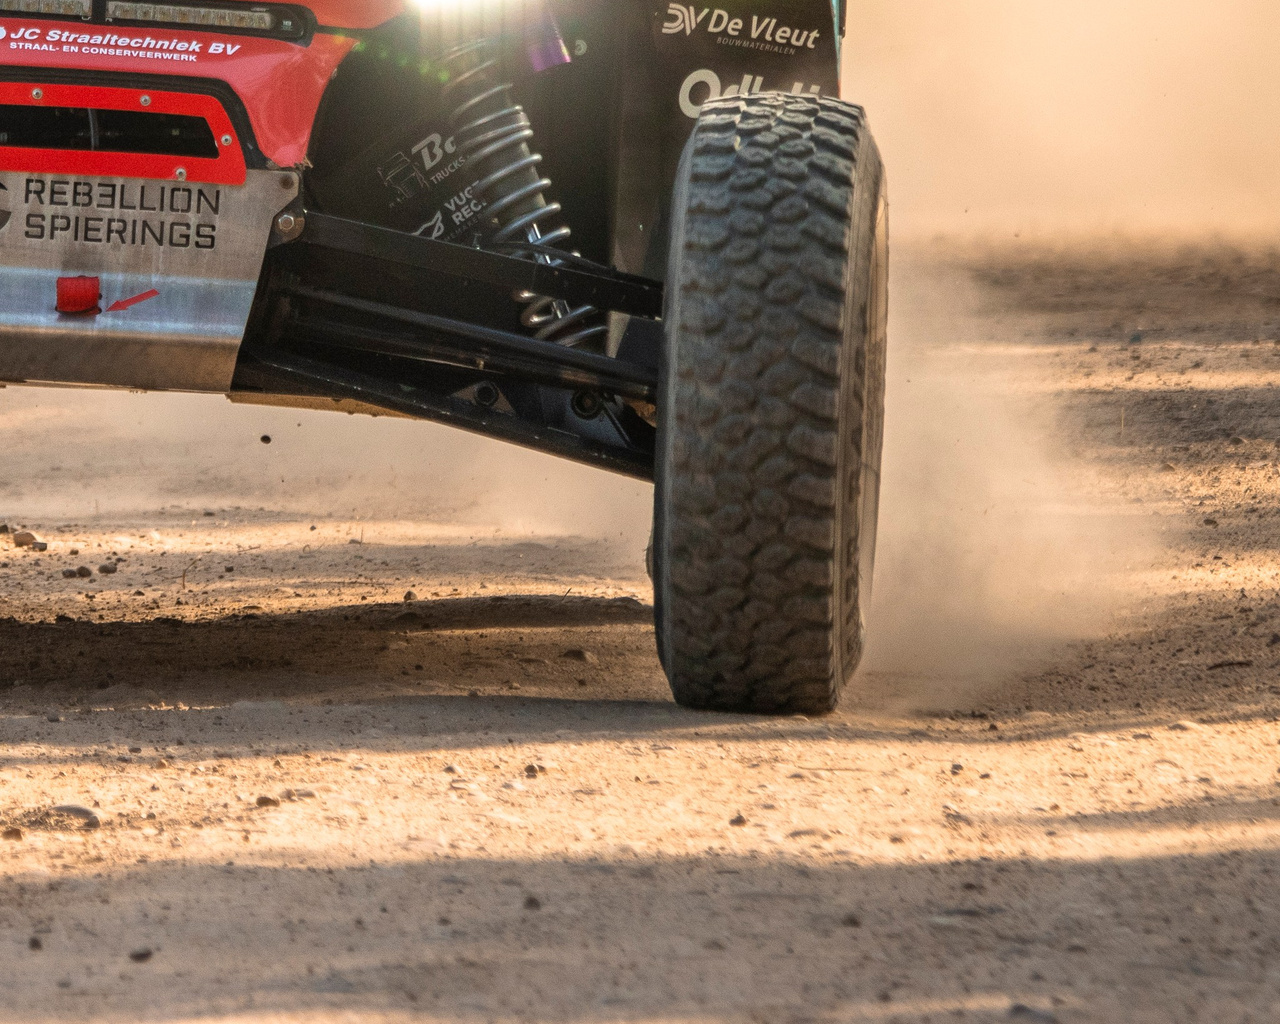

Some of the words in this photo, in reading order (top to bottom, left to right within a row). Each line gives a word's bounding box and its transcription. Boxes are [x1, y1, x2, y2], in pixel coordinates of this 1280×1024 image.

[10, 27, 41, 40] JC
[45, 29, 203, 53] Straaltechniek
[208, 42, 241, 56] BV
[707, 9, 743, 36] De
[750, 15, 820, 49] Vleut
[9, 42, 59, 52] STRAAL-
[62, 45, 79, 53] EN
[81, 46, 198, 62] CONSERVEERWERK
[716, 37, 796, 56] BOUWMATERIALEN
[430, 156, 466, 184] TRUCKS
[24, 213, 217, 249] SPIERINGS
